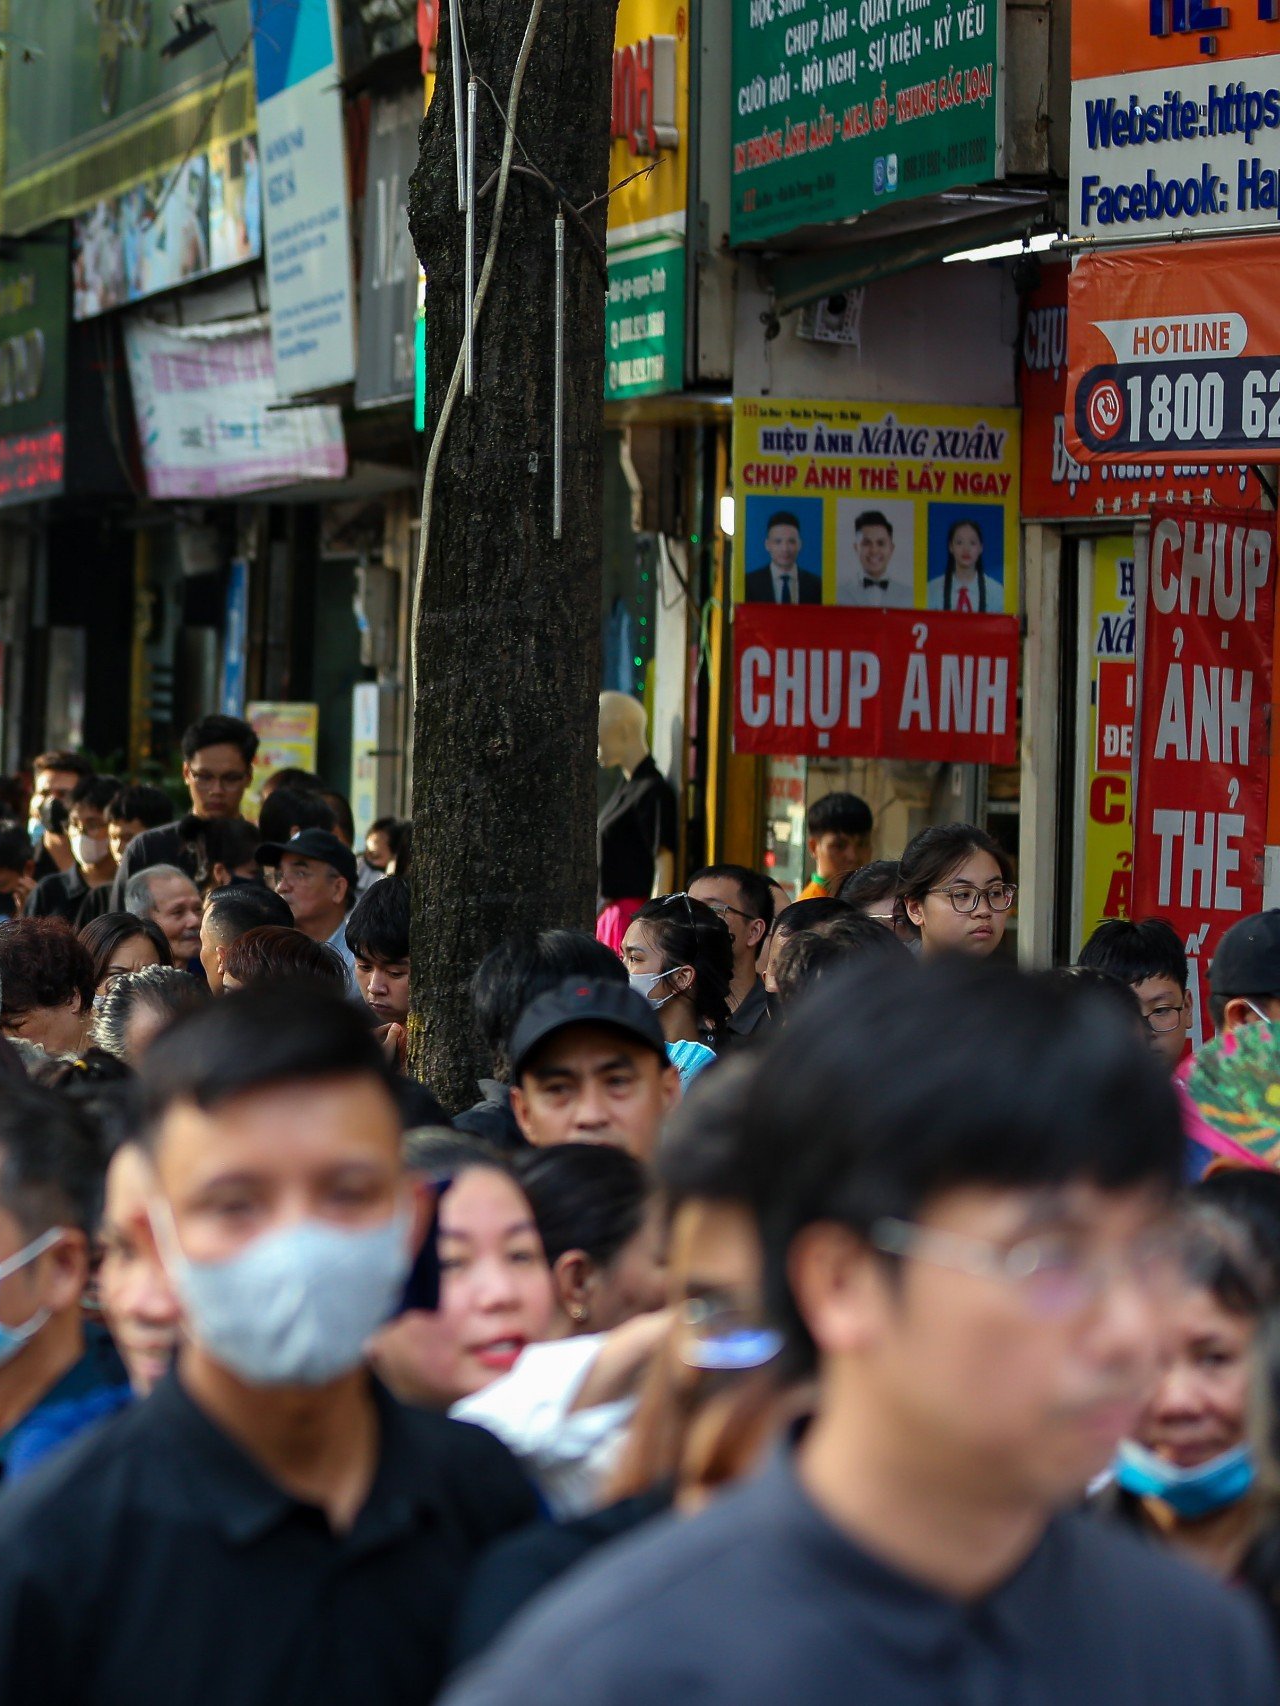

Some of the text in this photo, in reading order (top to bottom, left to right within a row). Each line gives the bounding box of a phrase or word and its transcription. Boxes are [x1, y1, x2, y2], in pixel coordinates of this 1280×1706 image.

[769, 62, 791, 105] HỎI
[801, 56, 823, 97] HỘI
[826, 48, 856, 85] NGHỊ
[868, 32, 887, 74] SỰ
[889, 21, 921, 65] KIỆN
[933, 3, 953, 50] KỶ
[785, 19, 818, 57] CHỤP
[821, 5, 848, 44] ẢNH
[895, 80, 936, 125] KHUNG
[964, 62, 993, 110] LOẠI
[1081, 158, 1280, 227] Facebook: Ha
[1024, 307, 1067, 382] CHỤ
[1132, 321, 1232, 356] HOTLINE
[762, 426, 807, 456] HIỆU
[814, 425, 853, 455] ẢNH
[933, 421, 1004, 460] XUÂN
[1126, 371, 1225, 442] 1800
[742, 458, 1012, 496] CHỤP ẢNH THẺ LẤY NGAY
[1151, 518, 1271, 650] CHỤP
[740, 623, 1008, 748] CHỤP ẢNH
[1153, 627, 1254, 766] ẢNH
[1152, 777, 1245, 911] THẺ
